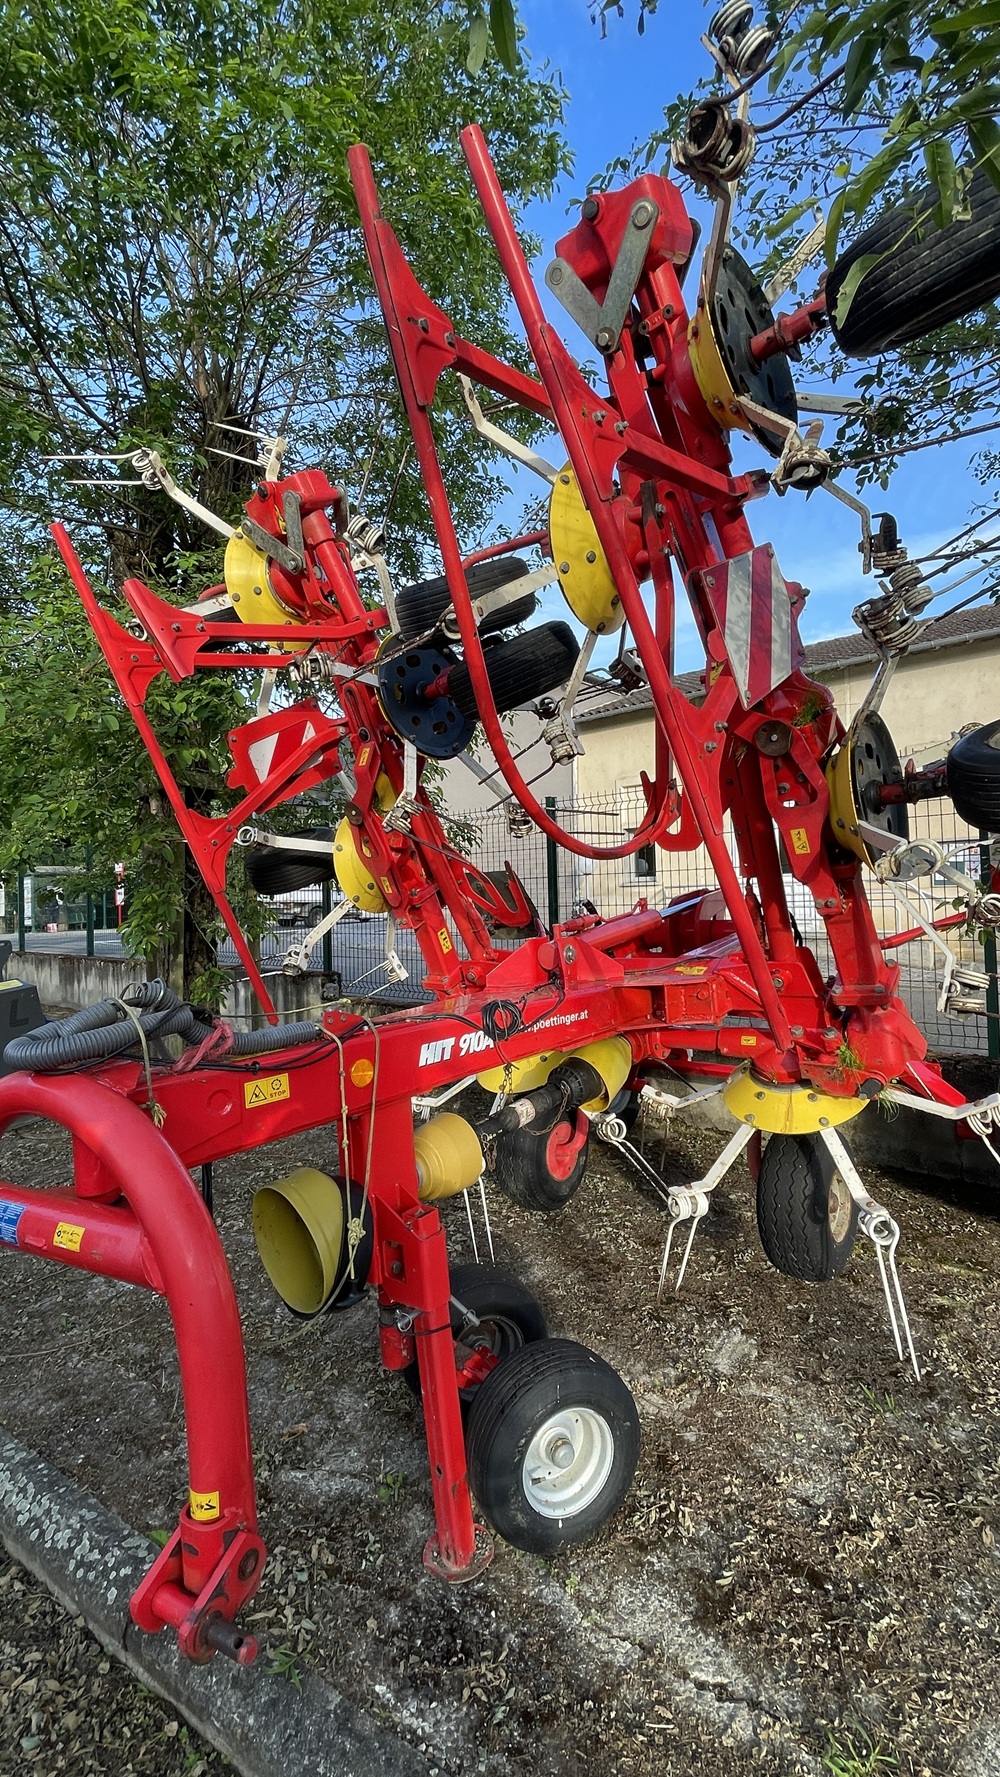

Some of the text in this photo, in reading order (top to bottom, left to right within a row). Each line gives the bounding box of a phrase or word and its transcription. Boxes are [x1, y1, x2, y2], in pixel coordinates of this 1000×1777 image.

[518, 1009, 588, 1033] .poettinger.at
[418, 1037, 456, 1068] HIT
[269, 1089, 287, 1099] STOP
